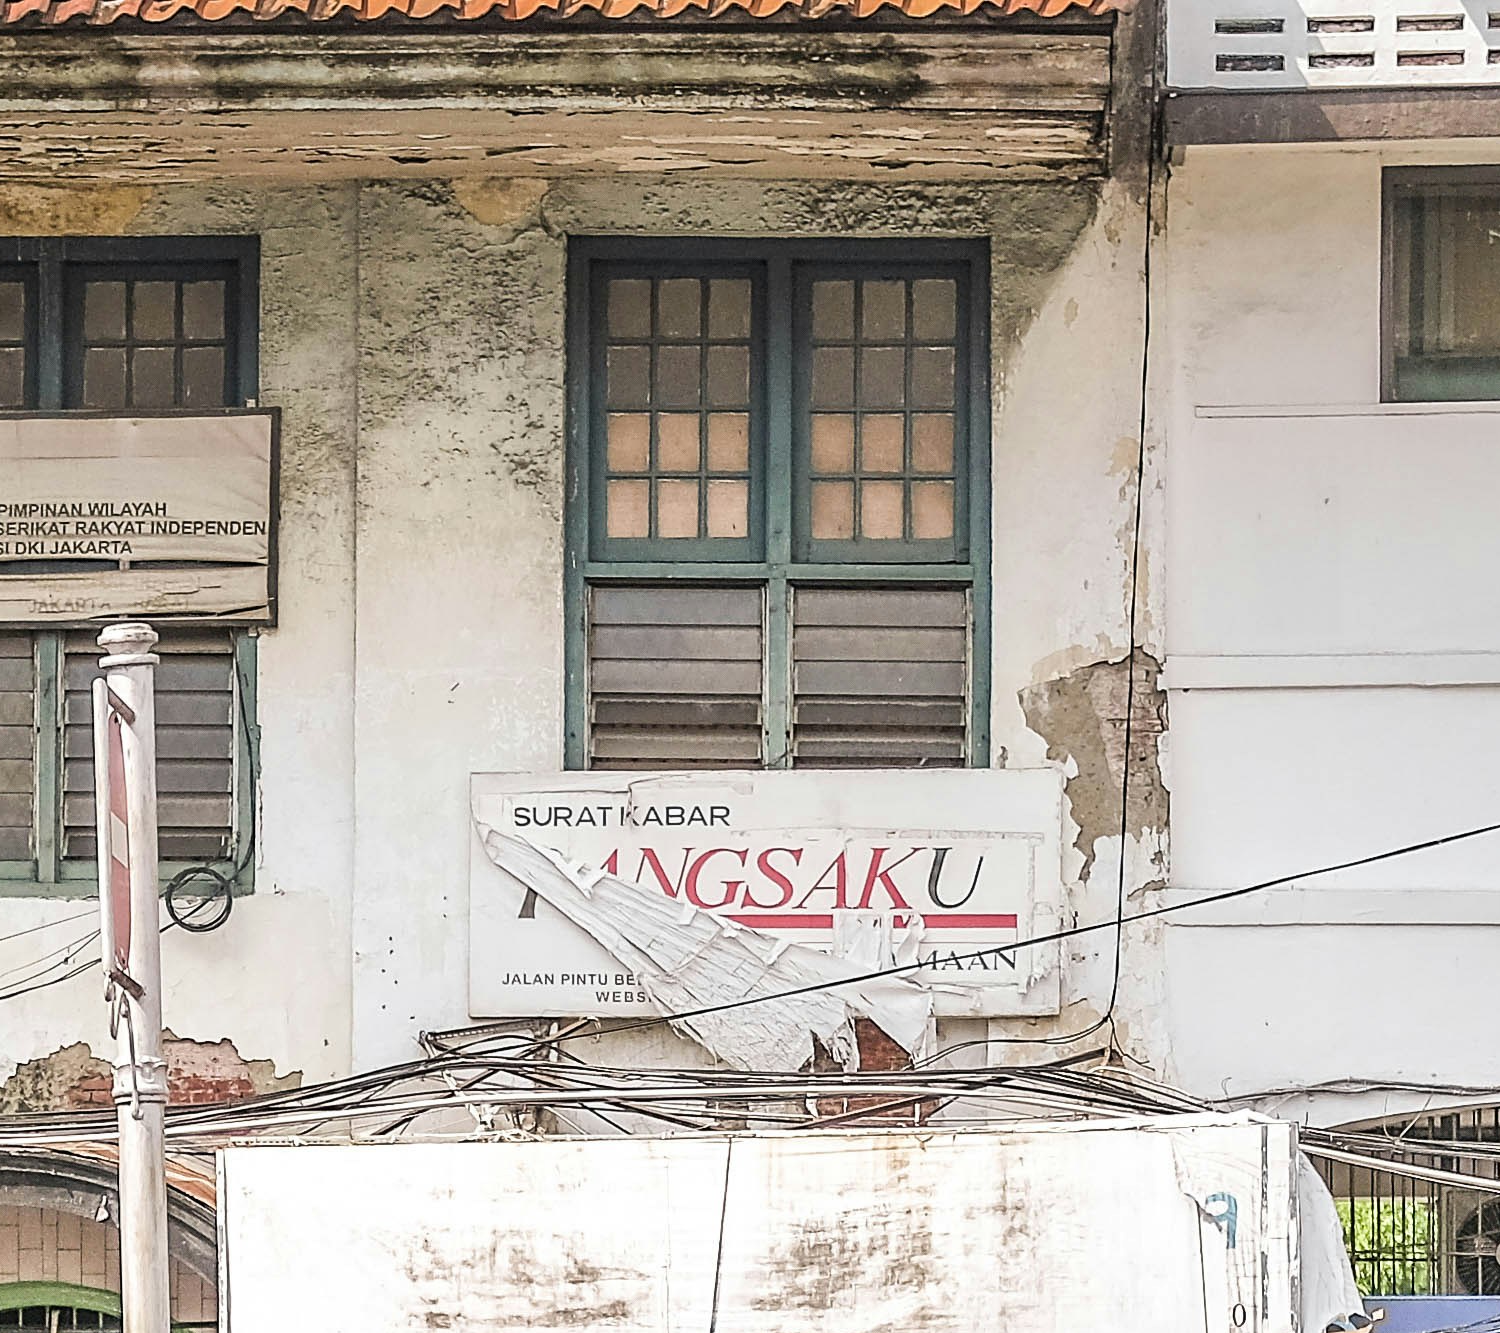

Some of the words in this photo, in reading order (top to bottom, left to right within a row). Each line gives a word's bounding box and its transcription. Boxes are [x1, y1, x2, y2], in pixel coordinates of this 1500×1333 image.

[88, 502, 167, 517] WILAYAH
[76, 521, 145, 535] RAKYAT
[151, 521, 266, 535] INDEPENDEN
[15, 541, 45, 555] DKI
[50, 541, 132, 554] JAKARTA
[513, 806, 613, 827] SURAT
[619, 806, 731, 827] KABAR
[502, 974, 555, 986] JALAN
[561, 974, 609, 986] PINTU
